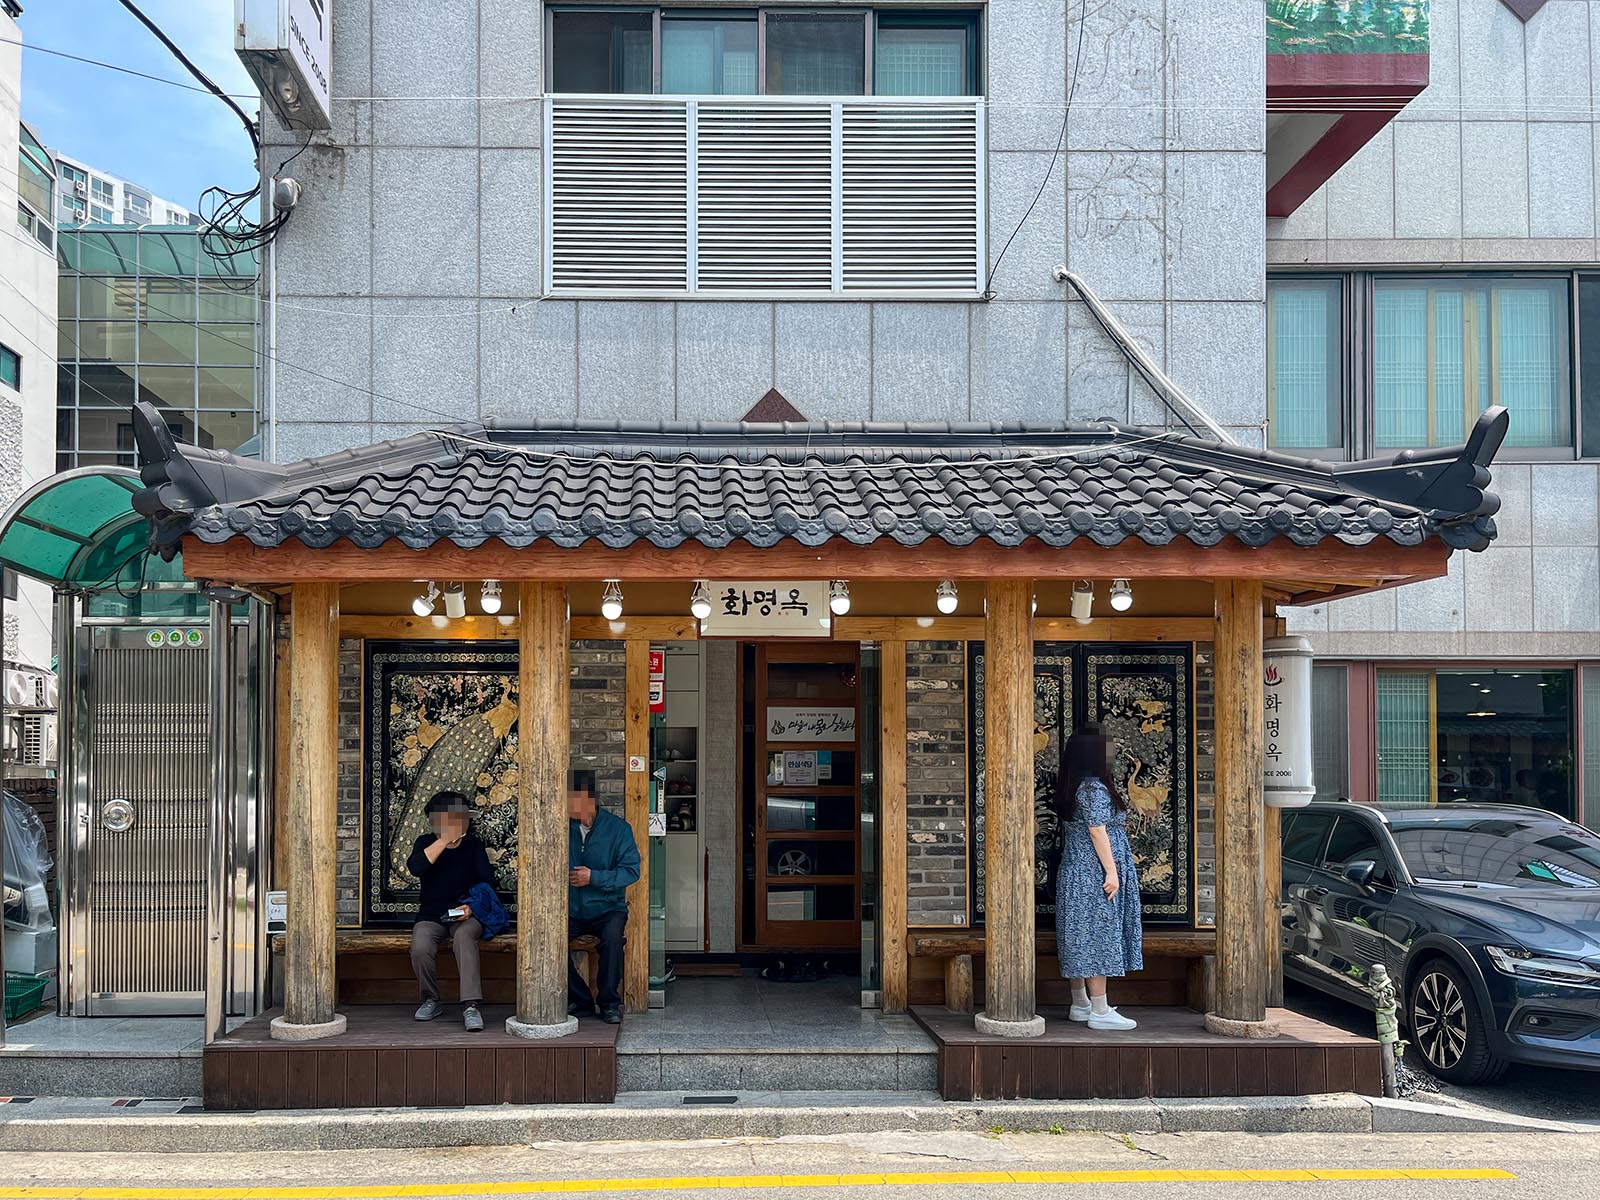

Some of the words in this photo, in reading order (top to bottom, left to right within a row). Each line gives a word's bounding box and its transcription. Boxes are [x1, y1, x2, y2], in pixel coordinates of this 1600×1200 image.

[290, 15, 311, 63] SINCE
[720, 587, 808, 616] 화명옥
[1265, 693, 1283, 762] 화명옥
[788, 760, 813, 769] 안심식당
